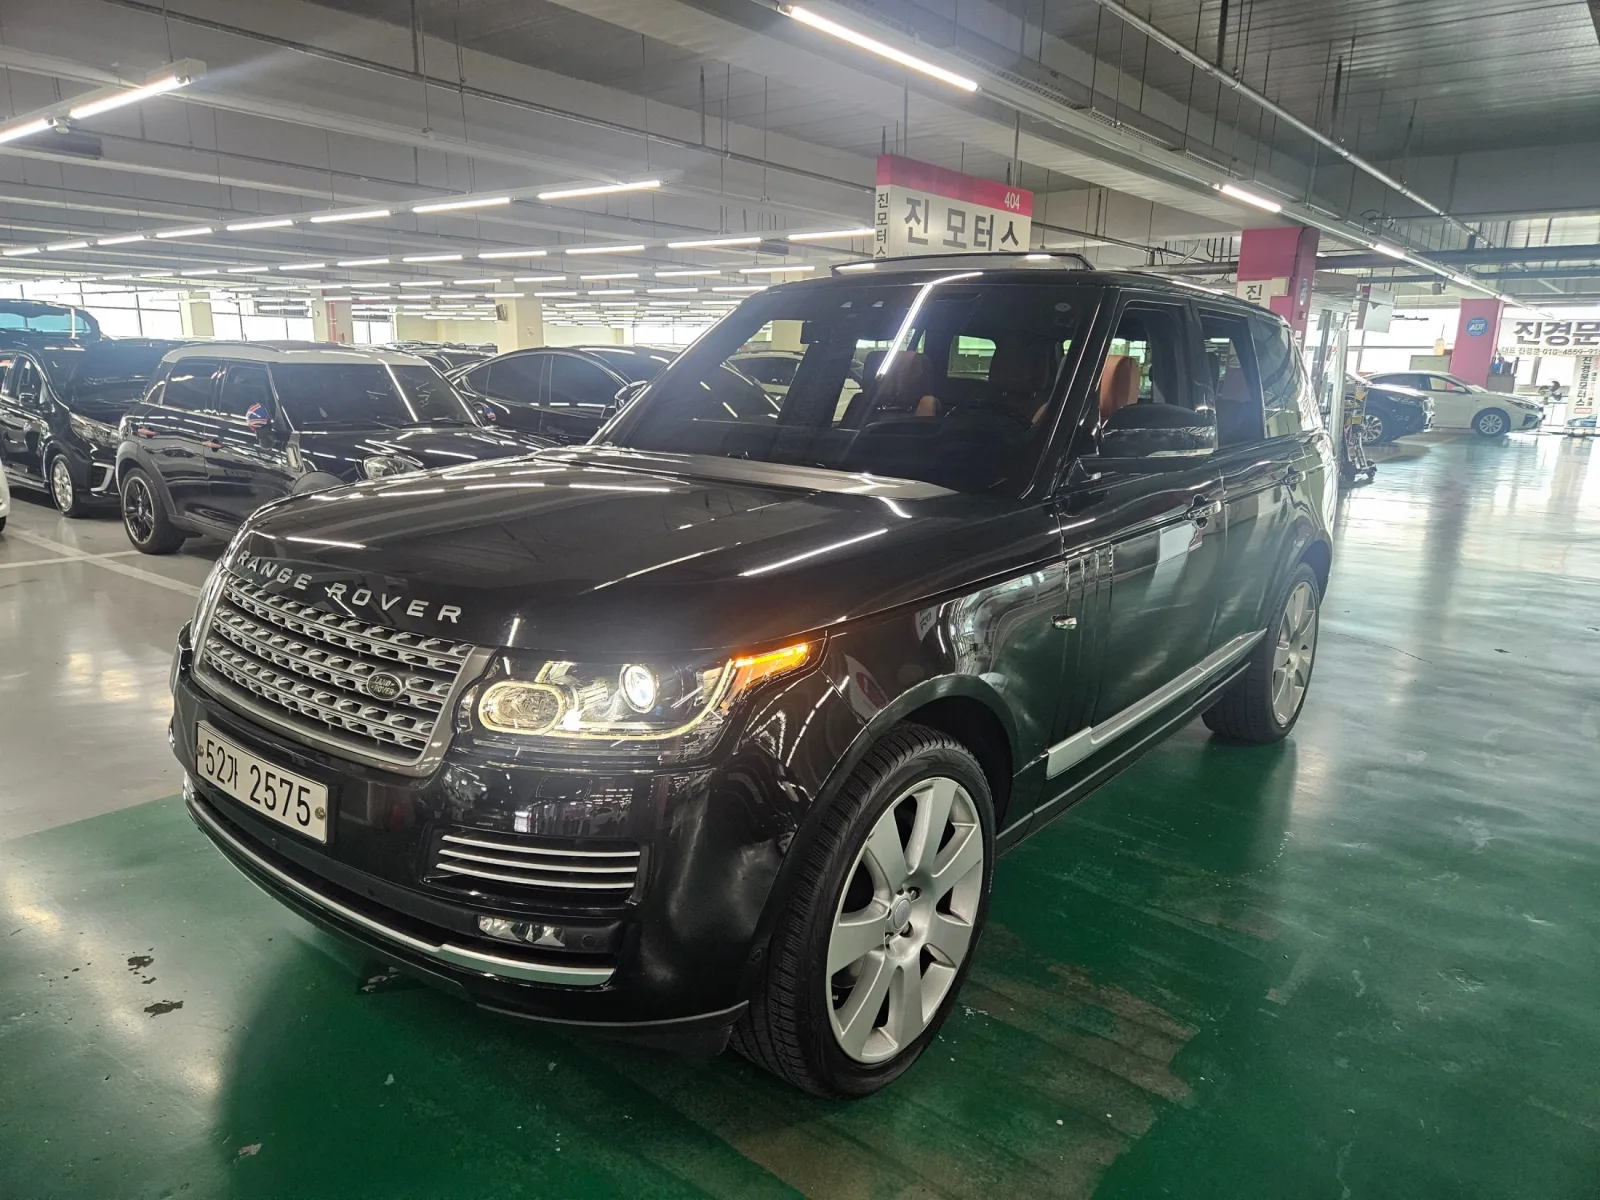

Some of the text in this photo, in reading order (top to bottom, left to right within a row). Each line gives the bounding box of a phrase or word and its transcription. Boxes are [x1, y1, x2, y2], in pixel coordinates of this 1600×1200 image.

[1004, 192, 1021, 210] 404
[1469, 323, 1486, 331] ADT
[1513, 321, 1600, 346] 진경문
[236, 549, 464, 624] RANGE ROVER
[204, 739, 312, 827] 52가 2575
